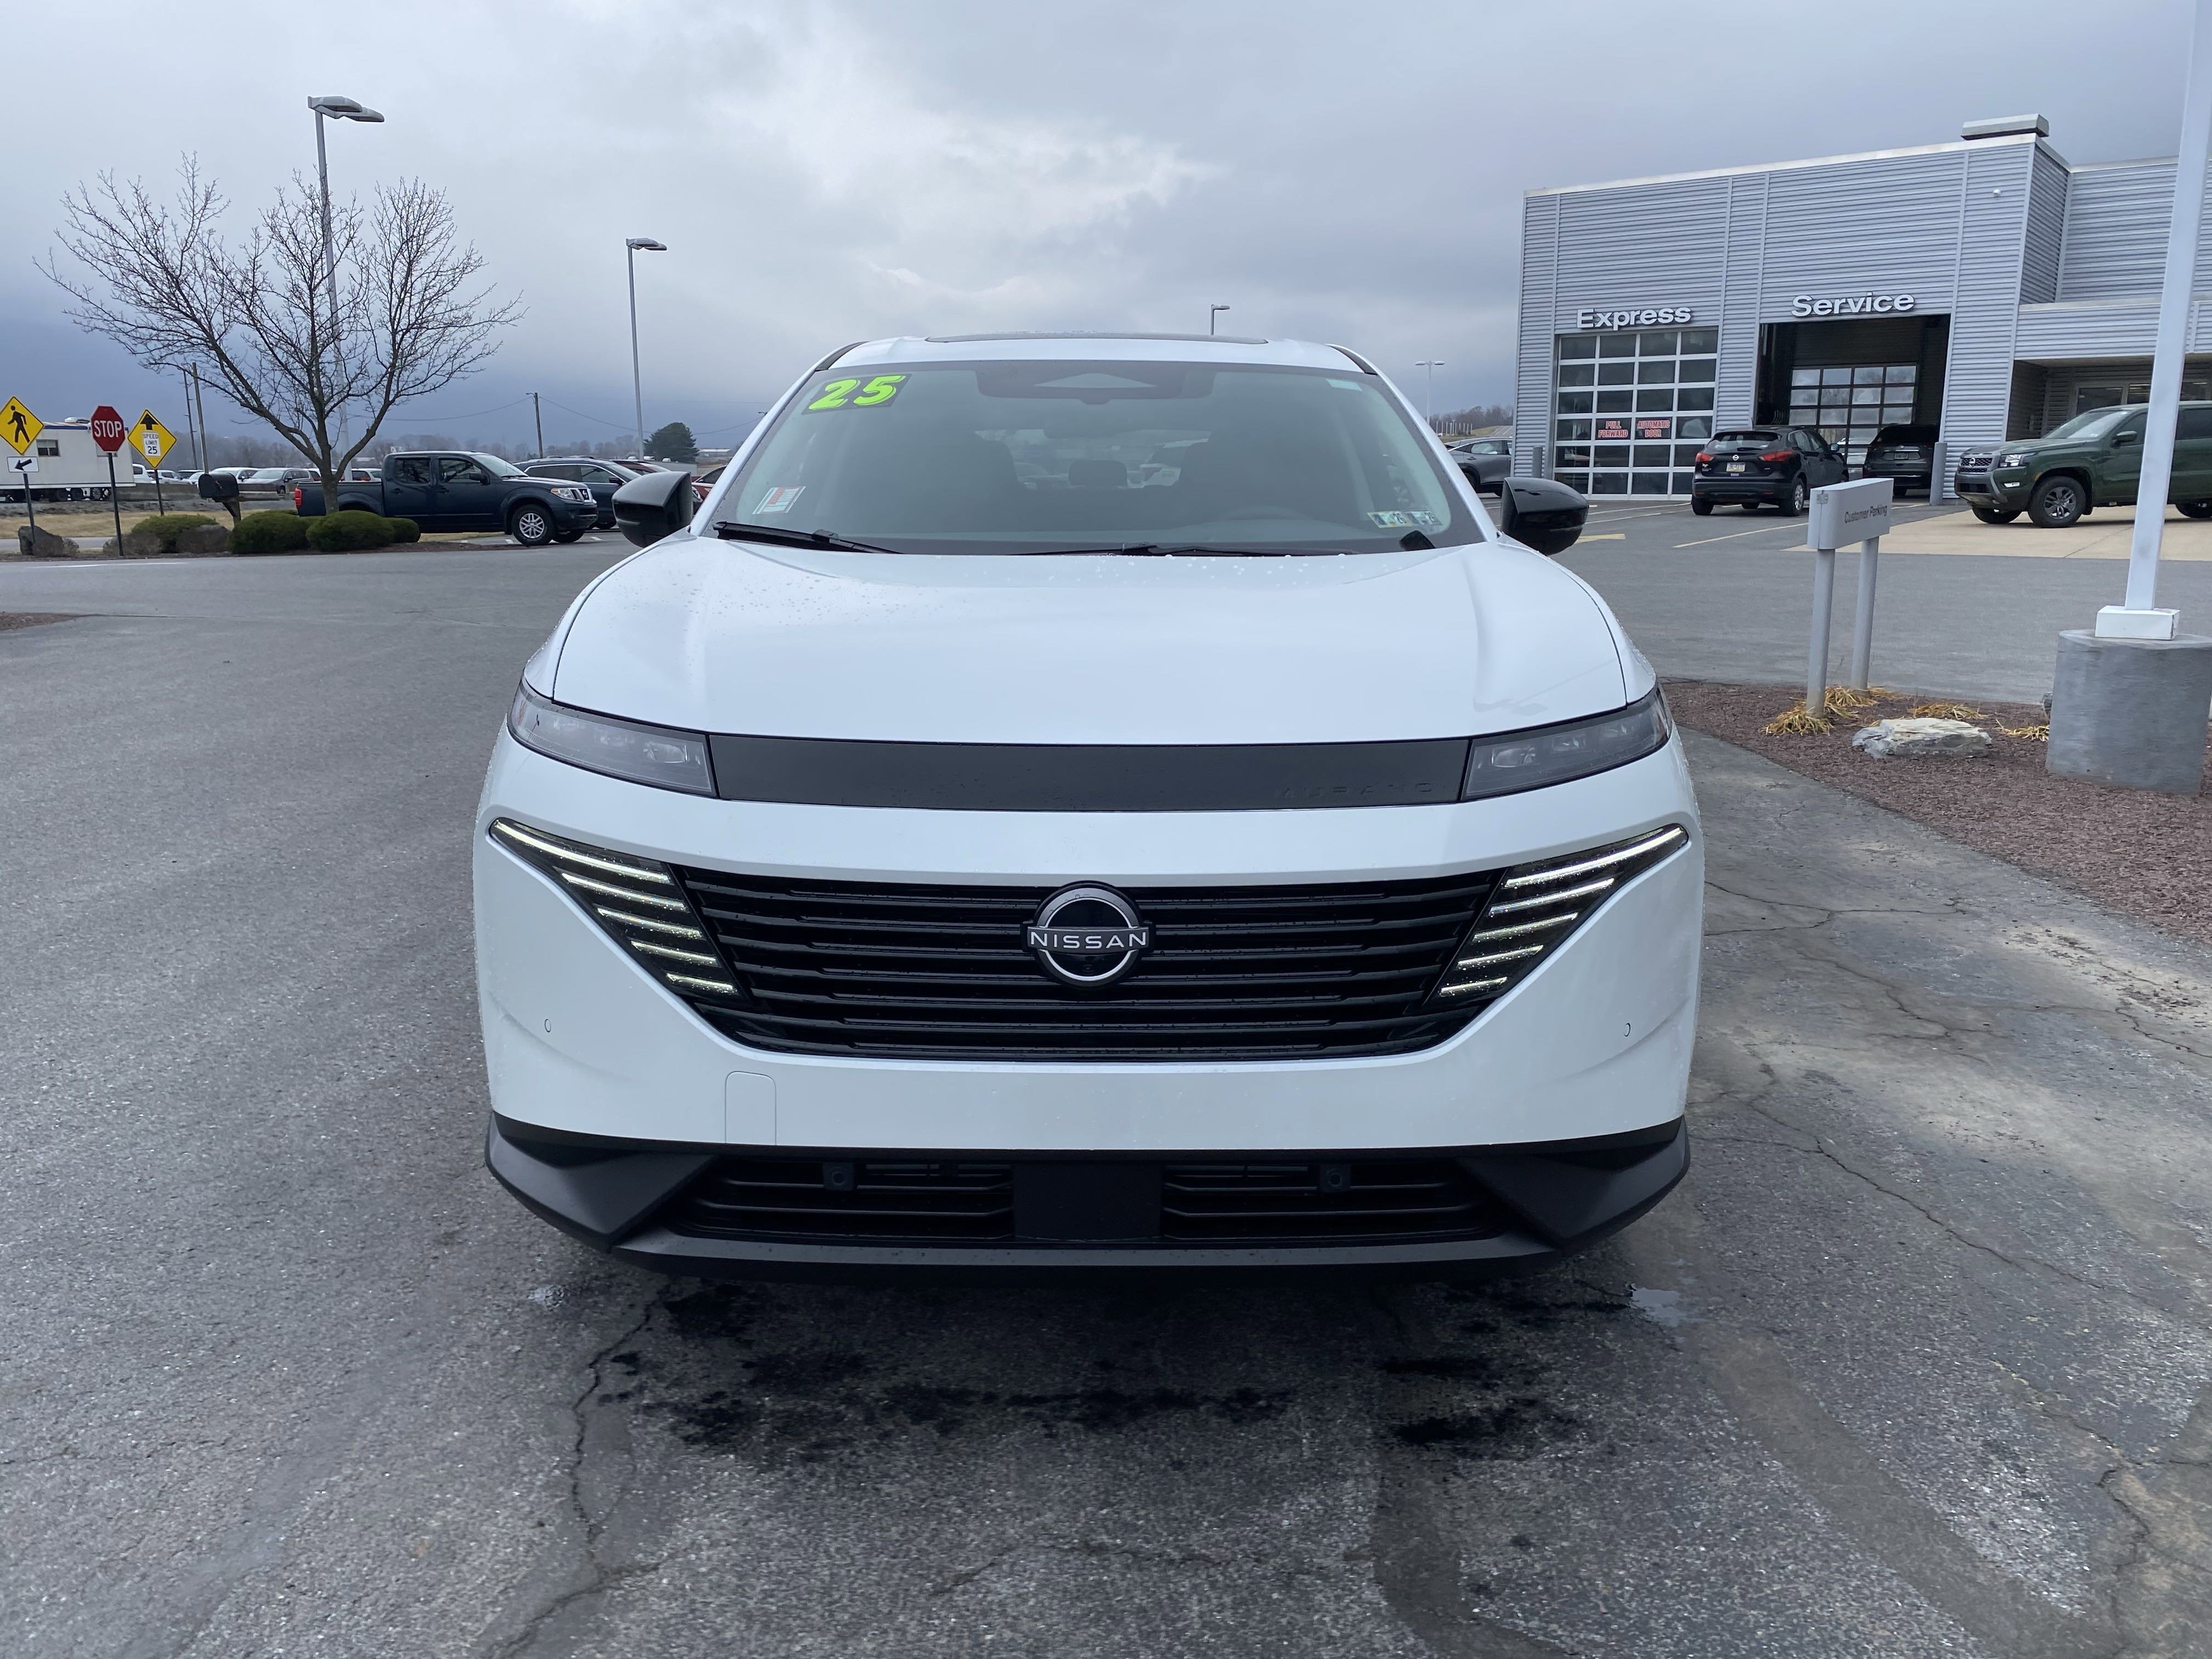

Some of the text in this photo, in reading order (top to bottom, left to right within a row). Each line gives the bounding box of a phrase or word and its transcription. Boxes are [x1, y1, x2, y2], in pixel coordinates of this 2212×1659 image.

[1791, 292, 1915, 317] Service
[1577, 307, 1691, 331] Express
[808, 375, 906, 410] 25
[94, 420, 122, 438] STOP
[1605, 421, 1622, 429] PULL
[1637, 420, 1671, 429] AUTOMATIC
[1598, 430, 1628, 438] FORWARD
[1645, 429, 1662, 438] DOOR
[148, 446, 157, 454] 25
[1844, 505, 1887, 523] Customer Parking
[1030, 932, 1146, 949] NISSAN
